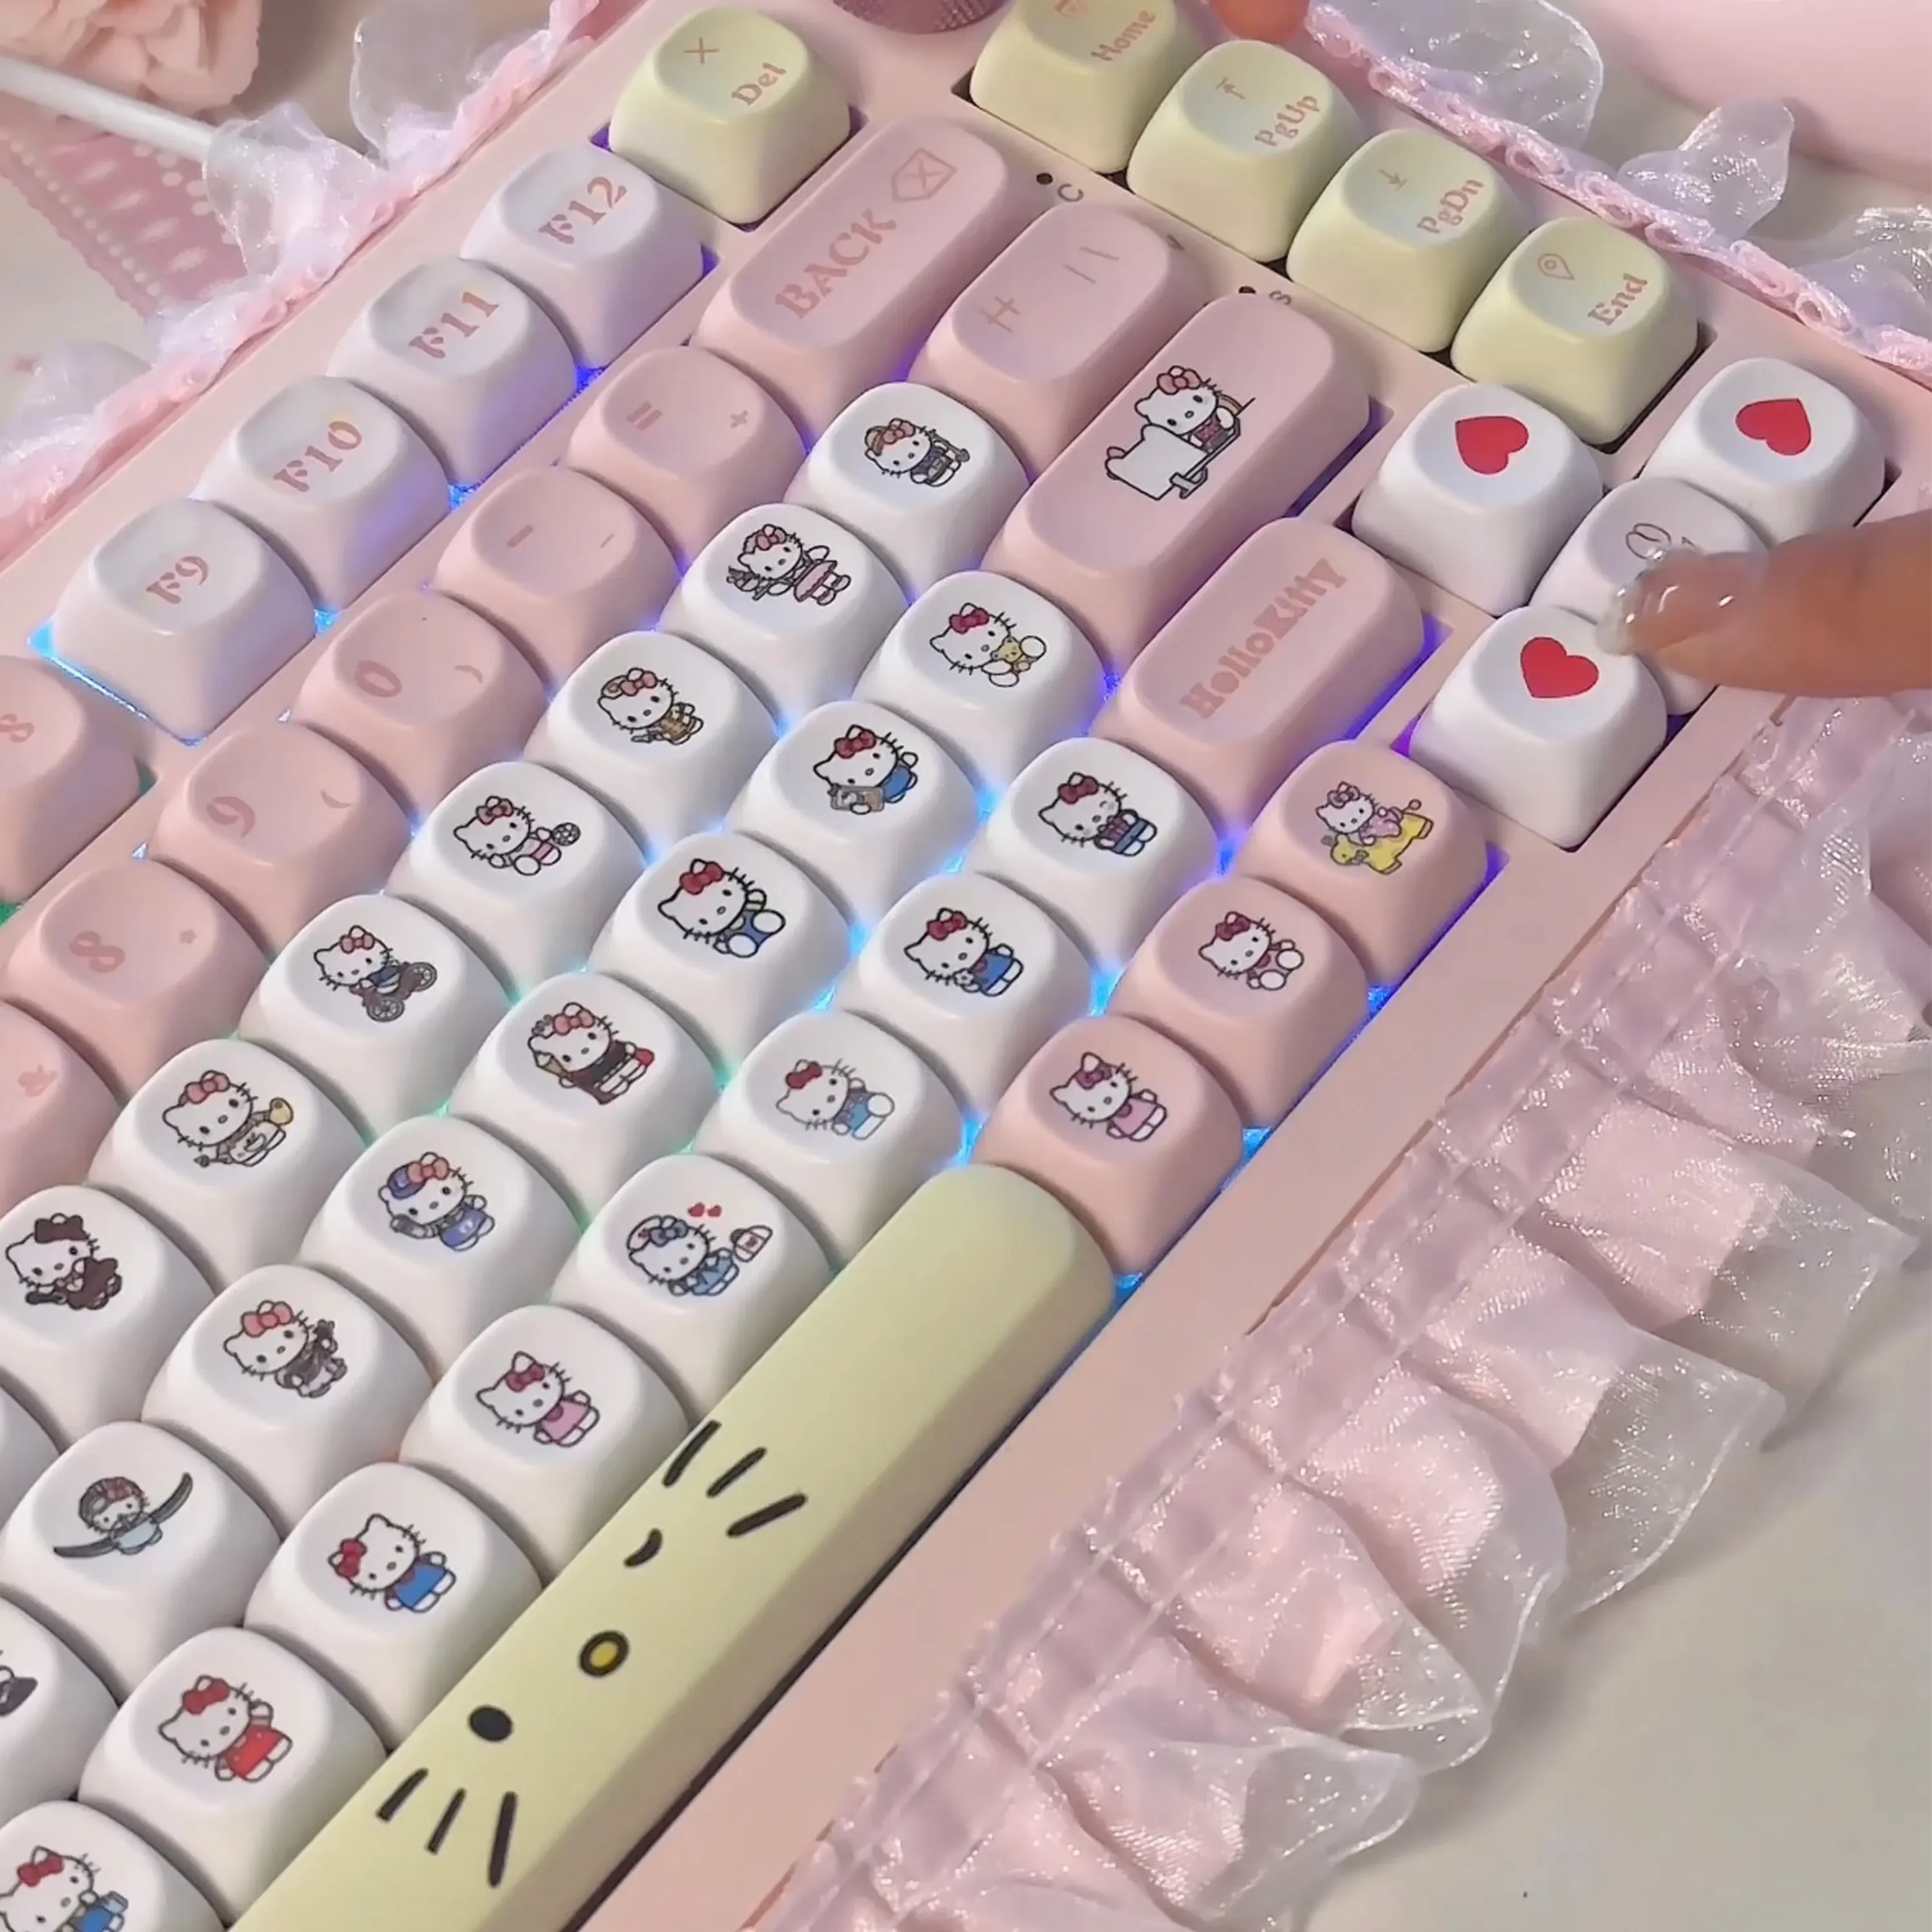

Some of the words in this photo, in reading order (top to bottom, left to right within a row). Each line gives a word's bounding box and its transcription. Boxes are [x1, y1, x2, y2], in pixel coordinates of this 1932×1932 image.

[1090, 10, 1156, 61] Home
[732, 62, 786, 106] Del
[1255, 95, 1321, 147] PgUp
[538, 176, 628, 245] F12
[1057, 183, 1084, 203] C
[1417, 179, 1484, 234] PgDn
[775, 207, 897, 319] BACK
[408, 290, 500, 360] F11
[1587, 273, 1648, 327] End
[272, 420, 363, 493] F10
[145, 555, 210, 605] F9
[354, 660, 402, 698] 0
[205, 795, 256, 838] 9
[69, 930, 126, 974] 8
